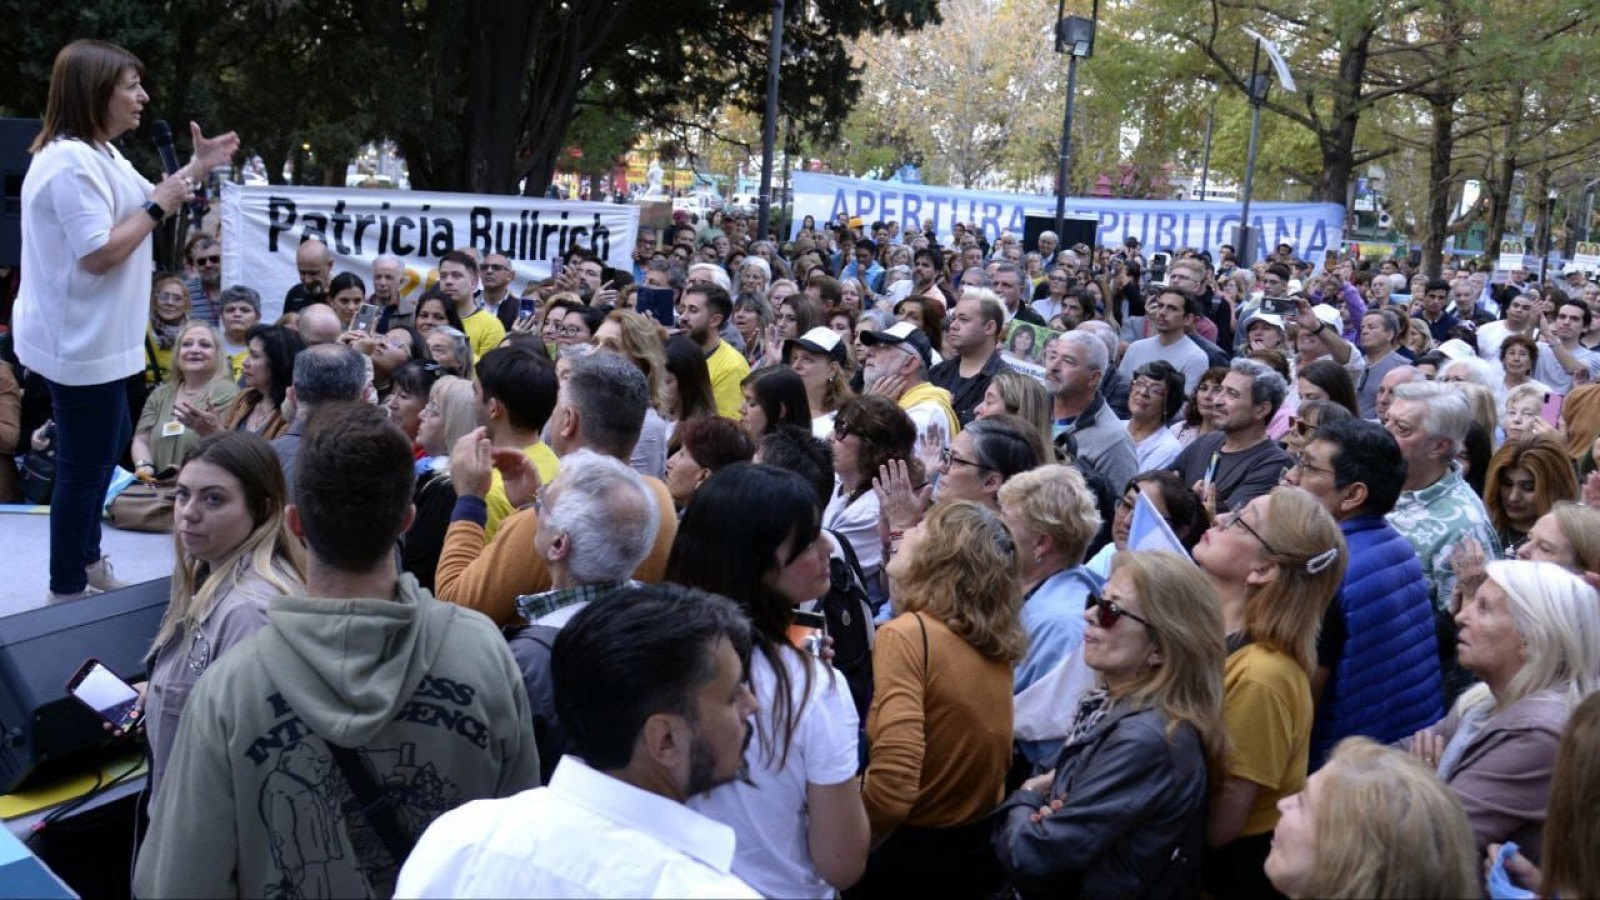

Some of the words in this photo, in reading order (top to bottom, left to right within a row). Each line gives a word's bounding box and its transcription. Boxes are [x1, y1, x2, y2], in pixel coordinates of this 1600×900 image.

[268, 196, 455, 257] Patricia
[470, 206, 610, 261] Bullrich
[829, 188, 1026, 239] APERTURA
[1047, 206, 1327, 262] PUBLICANA
